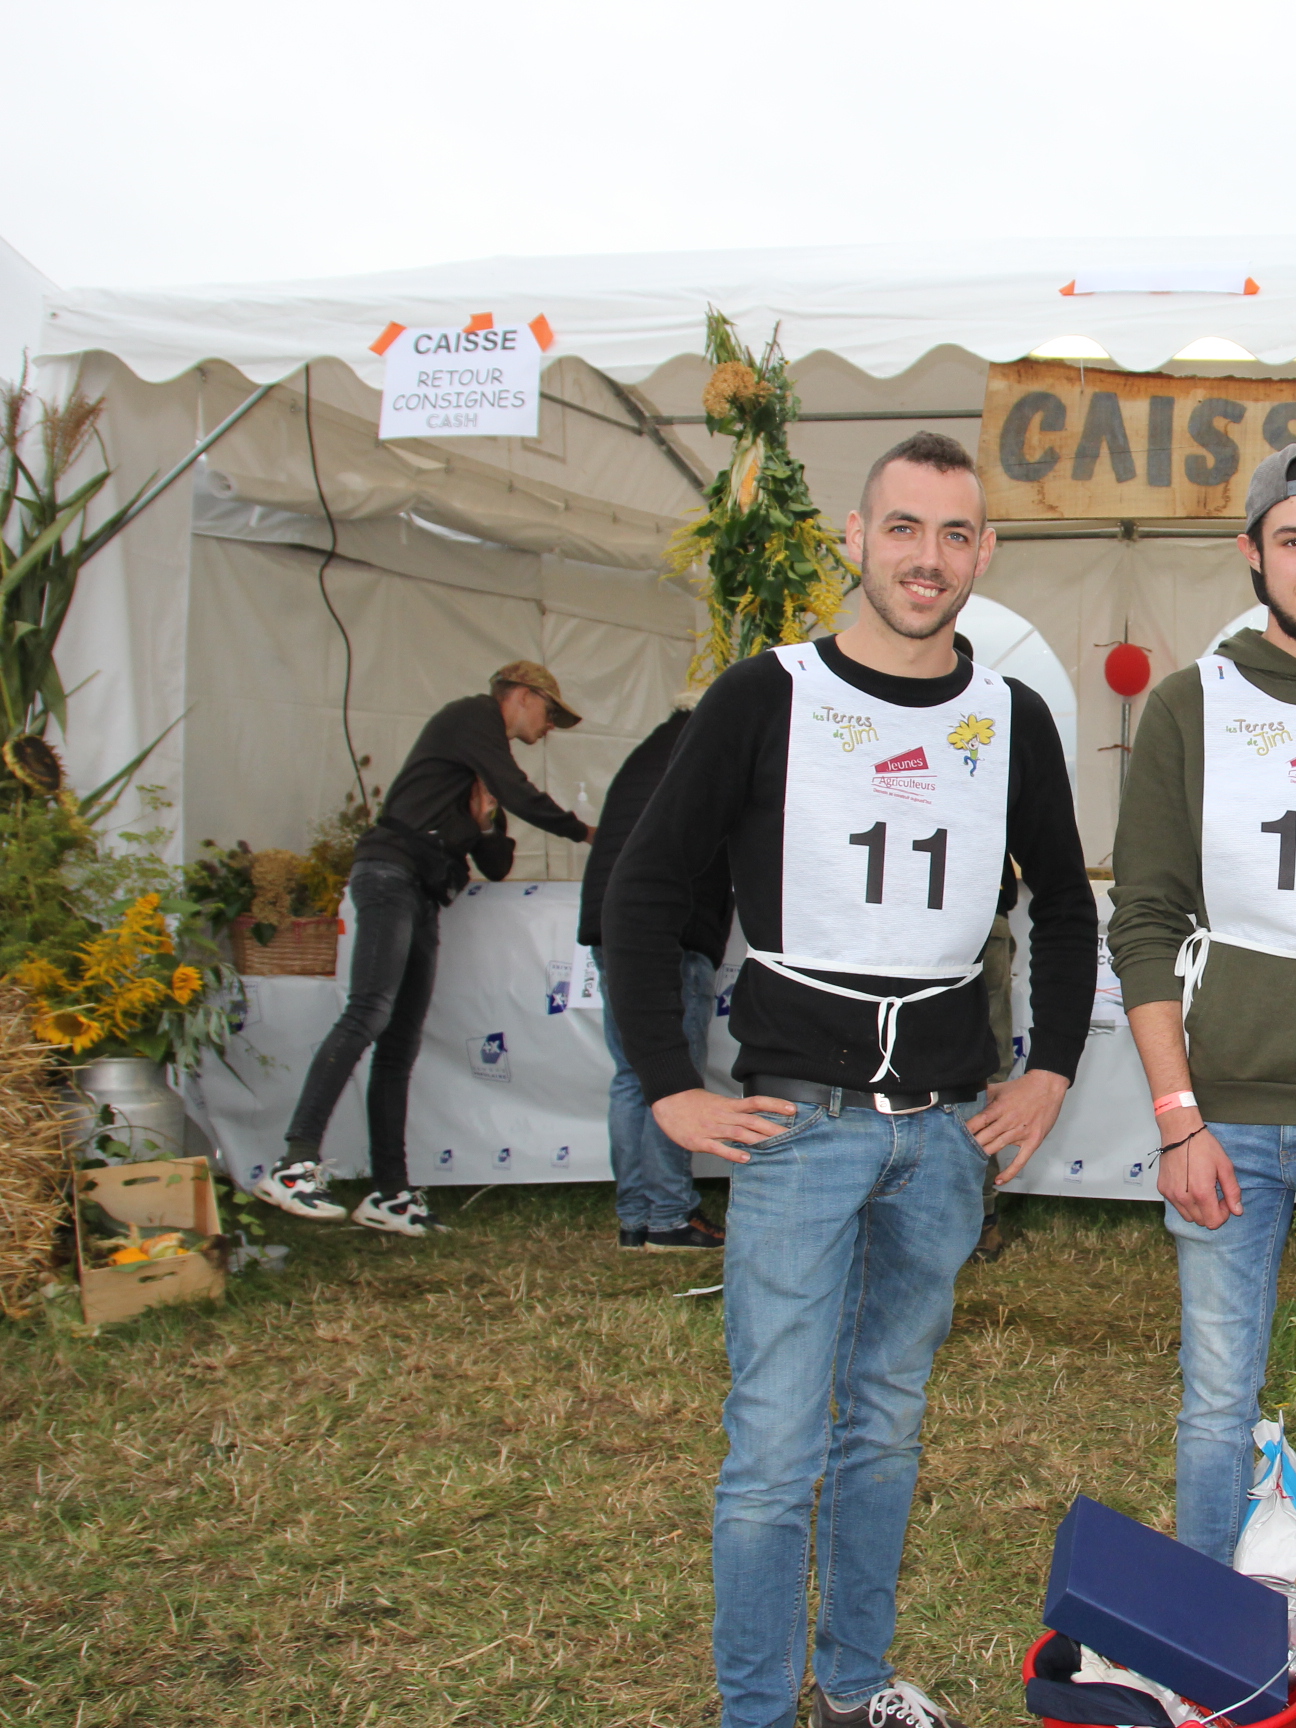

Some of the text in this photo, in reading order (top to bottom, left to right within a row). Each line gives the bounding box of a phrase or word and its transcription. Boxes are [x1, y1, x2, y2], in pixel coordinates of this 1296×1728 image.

[413, 330, 517, 355] CAISSE
[417, 367, 503, 388] RETOUR
[392, 389, 525, 411] CONSIGNES
[426, 413, 478, 428] CASH
[812, 706, 872, 728] les Terres
[1233, 719, 1285, 733] Terres
[833, 724, 879, 752] de Jim
[1247, 730, 1293, 756] de Jim
[886, 757, 924, 772] Jeunes
[879, 775, 936, 791] Agriculteurs
[849, 821, 948, 910] 11
